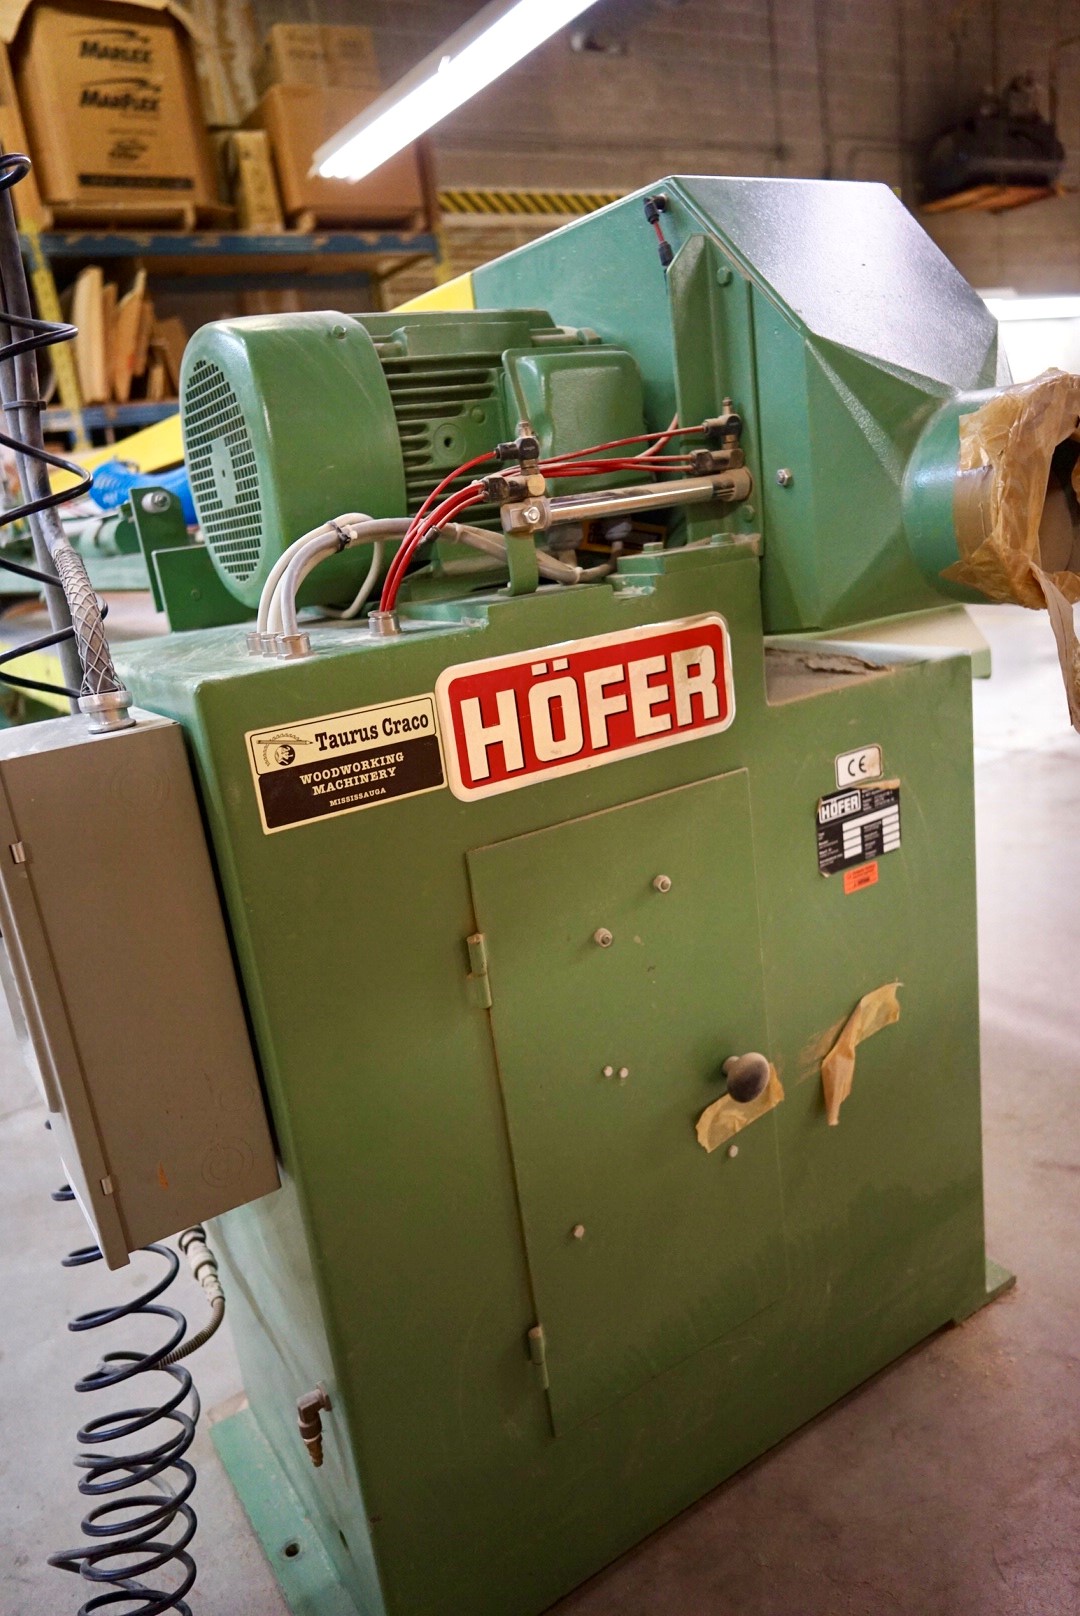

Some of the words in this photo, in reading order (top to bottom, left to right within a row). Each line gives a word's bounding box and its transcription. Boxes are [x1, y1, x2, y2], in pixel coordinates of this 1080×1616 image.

[460, 644, 721, 782] HÖFER
[314, 725, 379, 751] Taurus
[382, 713, 429, 738] Craco
[299, 751, 405, 785] WOODWORKING
[312, 766, 398, 796] MACHINERY
[847, 755, 867, 777] CE
[329, 787, 387, 807] MISSISSAUGA
[821, 795, 859, 820] HÖFER
